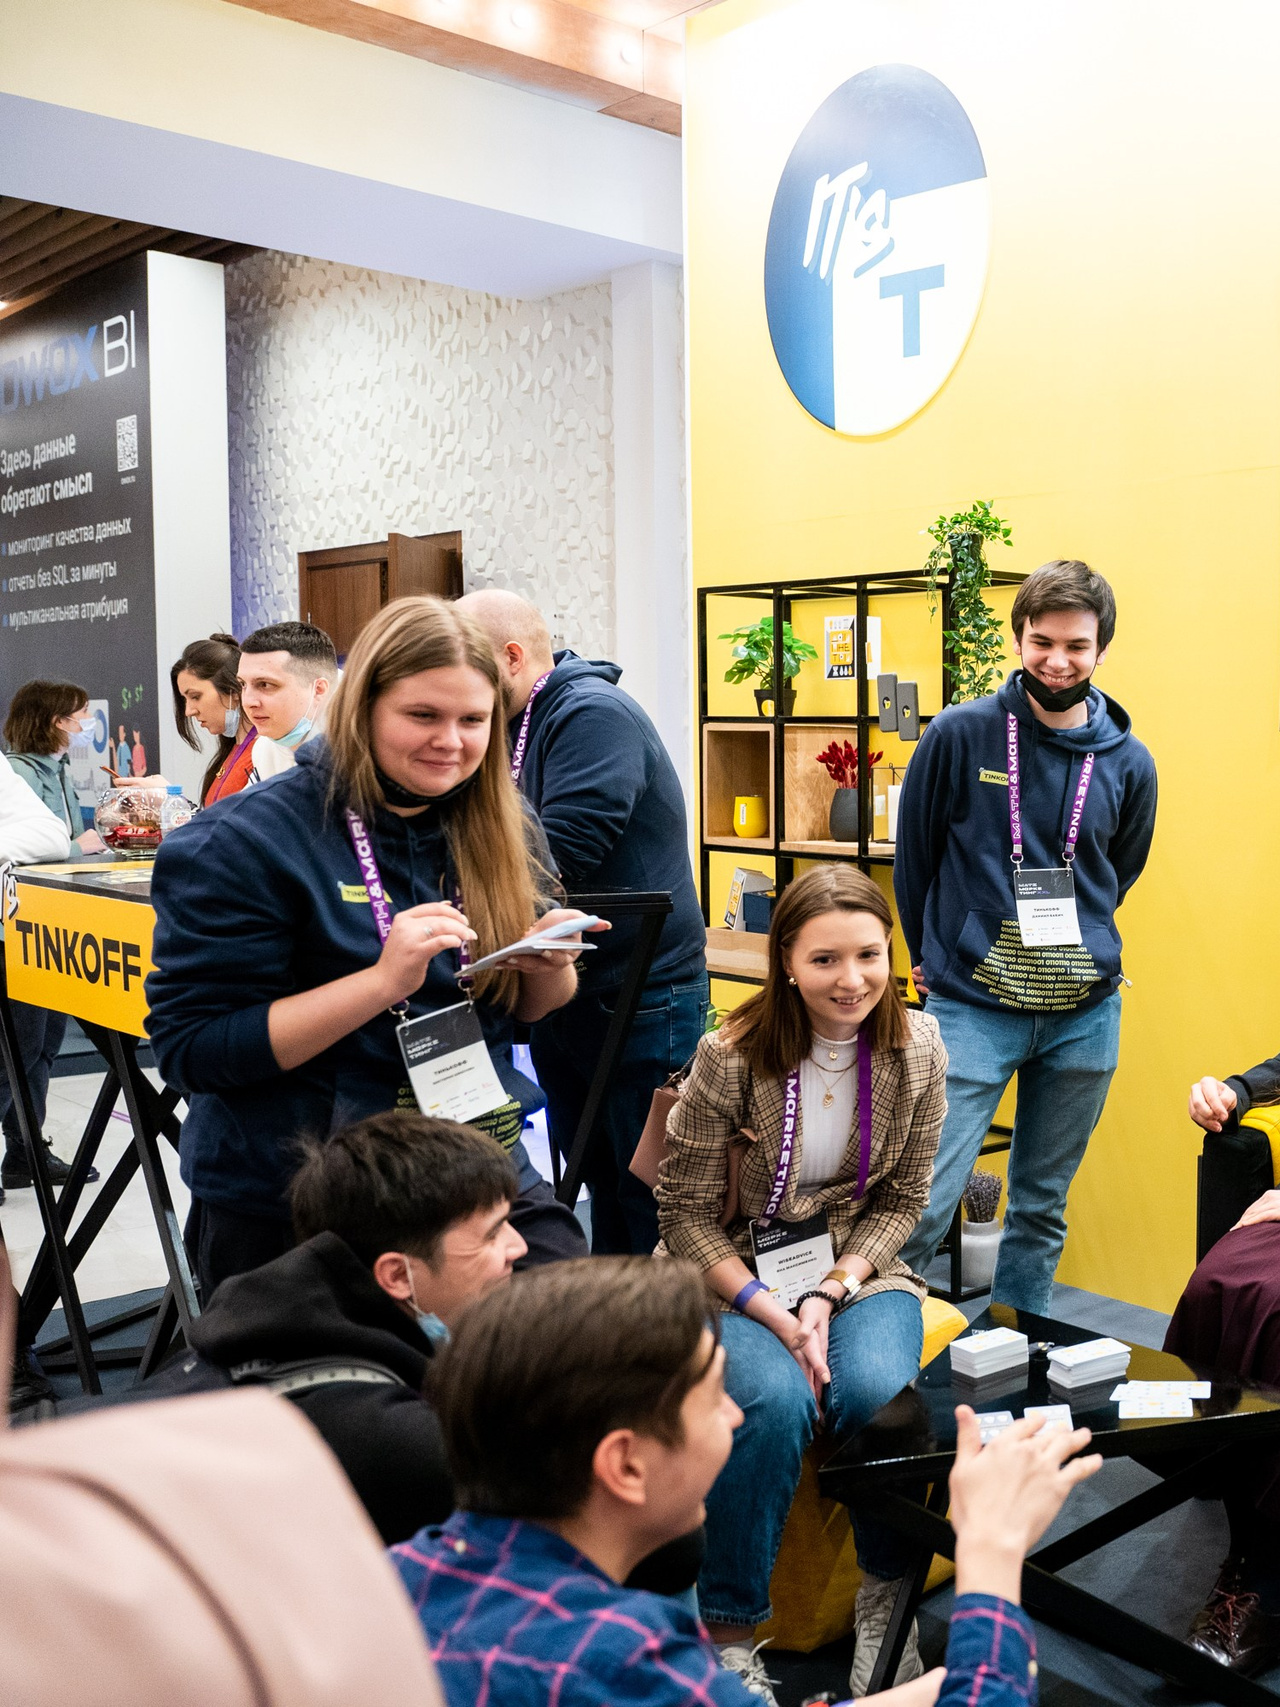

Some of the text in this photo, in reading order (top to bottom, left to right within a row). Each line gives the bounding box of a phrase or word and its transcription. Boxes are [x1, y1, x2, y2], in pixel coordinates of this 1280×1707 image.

[879, 264, 945, 358] T
[103, 310, 136, 378] BI
[0, 433, 76, 478] Здесь данные
[0, 472, 93, 517] обретают смысл
[8, 517, 132, 556] мониторинг качества данных
[8, 561, 117, 593] отчеты без SQL за минуты
[81, 595, 128, 623] атрибуция
[511, 768, 520, 780] &
[1009, 772, 1018, 784] &
[1010, 786, 1021, 839] MATH
[369, 881, 382, 898] &
[15, 919, 142, 992] TINKOFF
[778, 1250, 812, 1265] WISEADVICE
